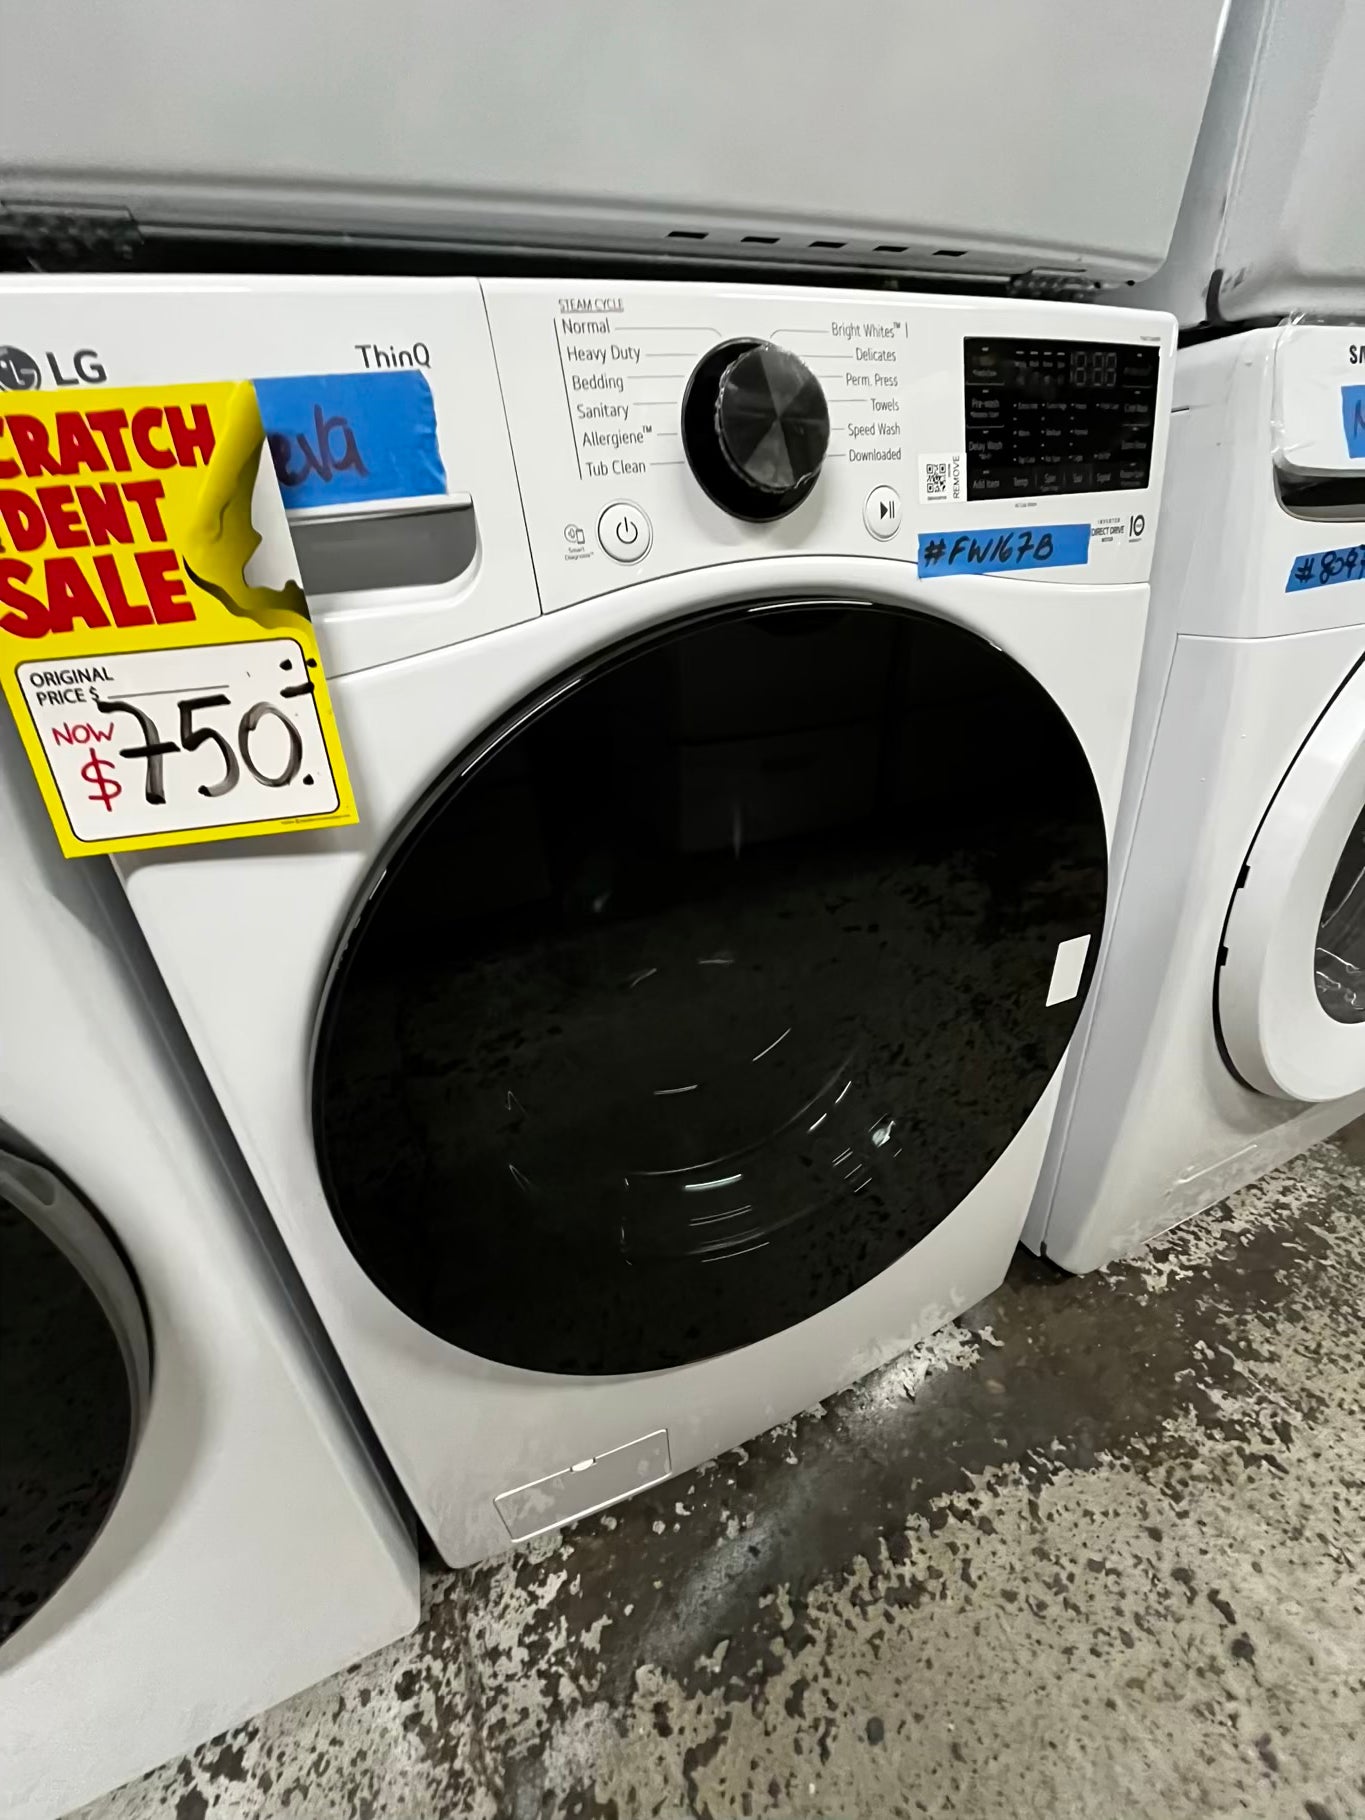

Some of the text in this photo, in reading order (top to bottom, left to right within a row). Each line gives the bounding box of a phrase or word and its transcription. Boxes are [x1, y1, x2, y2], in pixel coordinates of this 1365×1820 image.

[558, 298, 624, 312] STEAM CYCLE
[562, 317, 610, 334] Normal
[831, 321, 861, 341] Bright
[354, 343, 431, 369] ThinQ
[566, 344, 641, 365] Heavy Duty
[855, 347, 897, 362] Delicates
[45, 348, 108, 386] LG
[571, 374, 624, 392] Bedding
[845, 372, 899, 387] Perm. Press
[577, 402, 630, 421] Sanitary
[870, 397, 900, 411] Towels
[847, 421, 901, 439] Speed Wash
[848, 447, 902, 462] Downloaded
[585, 459, 647, 477] Tub Clean
[952, 455, 960, 499] REMOVE
[0, 480, 167, 552] DENT
[1091, 524, 1125, 537] DIRECT DRIVE
[0, 549, 196, 639] SALE
[29, 666, 115, 688] ORIGINAL
[36, 688, 85, 706] PRICE
[52, 721, 115, 746] NOW
[80, 747, 123, 812] $
